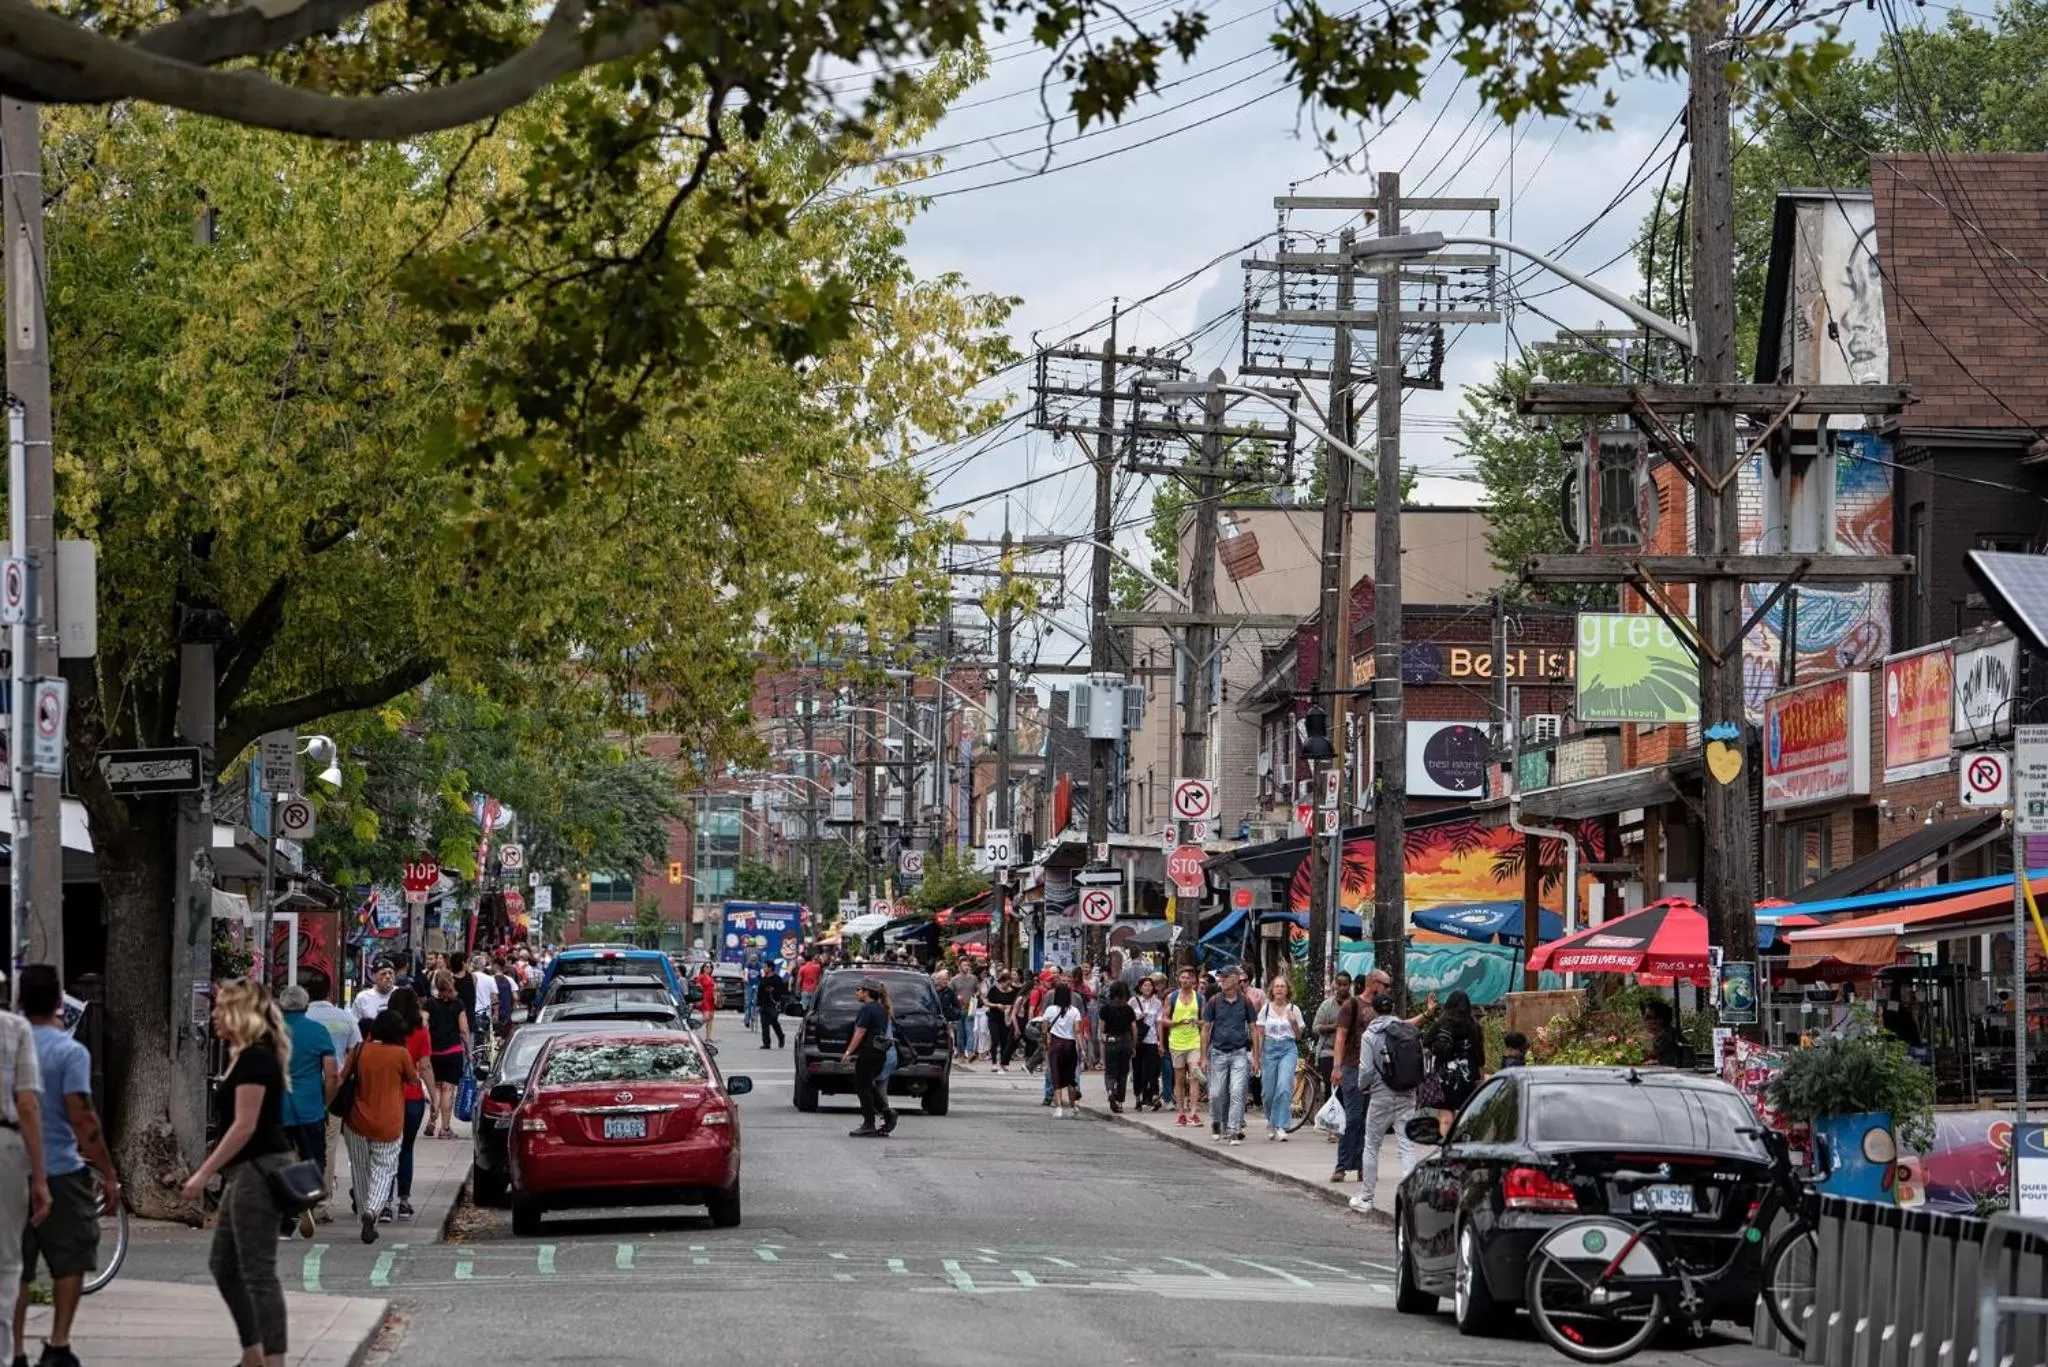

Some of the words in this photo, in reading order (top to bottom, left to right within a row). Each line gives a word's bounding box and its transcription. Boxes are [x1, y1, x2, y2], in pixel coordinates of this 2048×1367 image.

[1451, 648, 1527, 677] Best
[1590, 708, 1617, 718] health
[1628, 708, 1660, 719] beauty
[988, 844, 1008, 861] 30
[1171, 858, 1203, 875] STO
[1559, 955, 1579, 967] GREAT
[1579, 954, 1599, 965] BEER
[1599, 954, 1617, 965] LIVES
